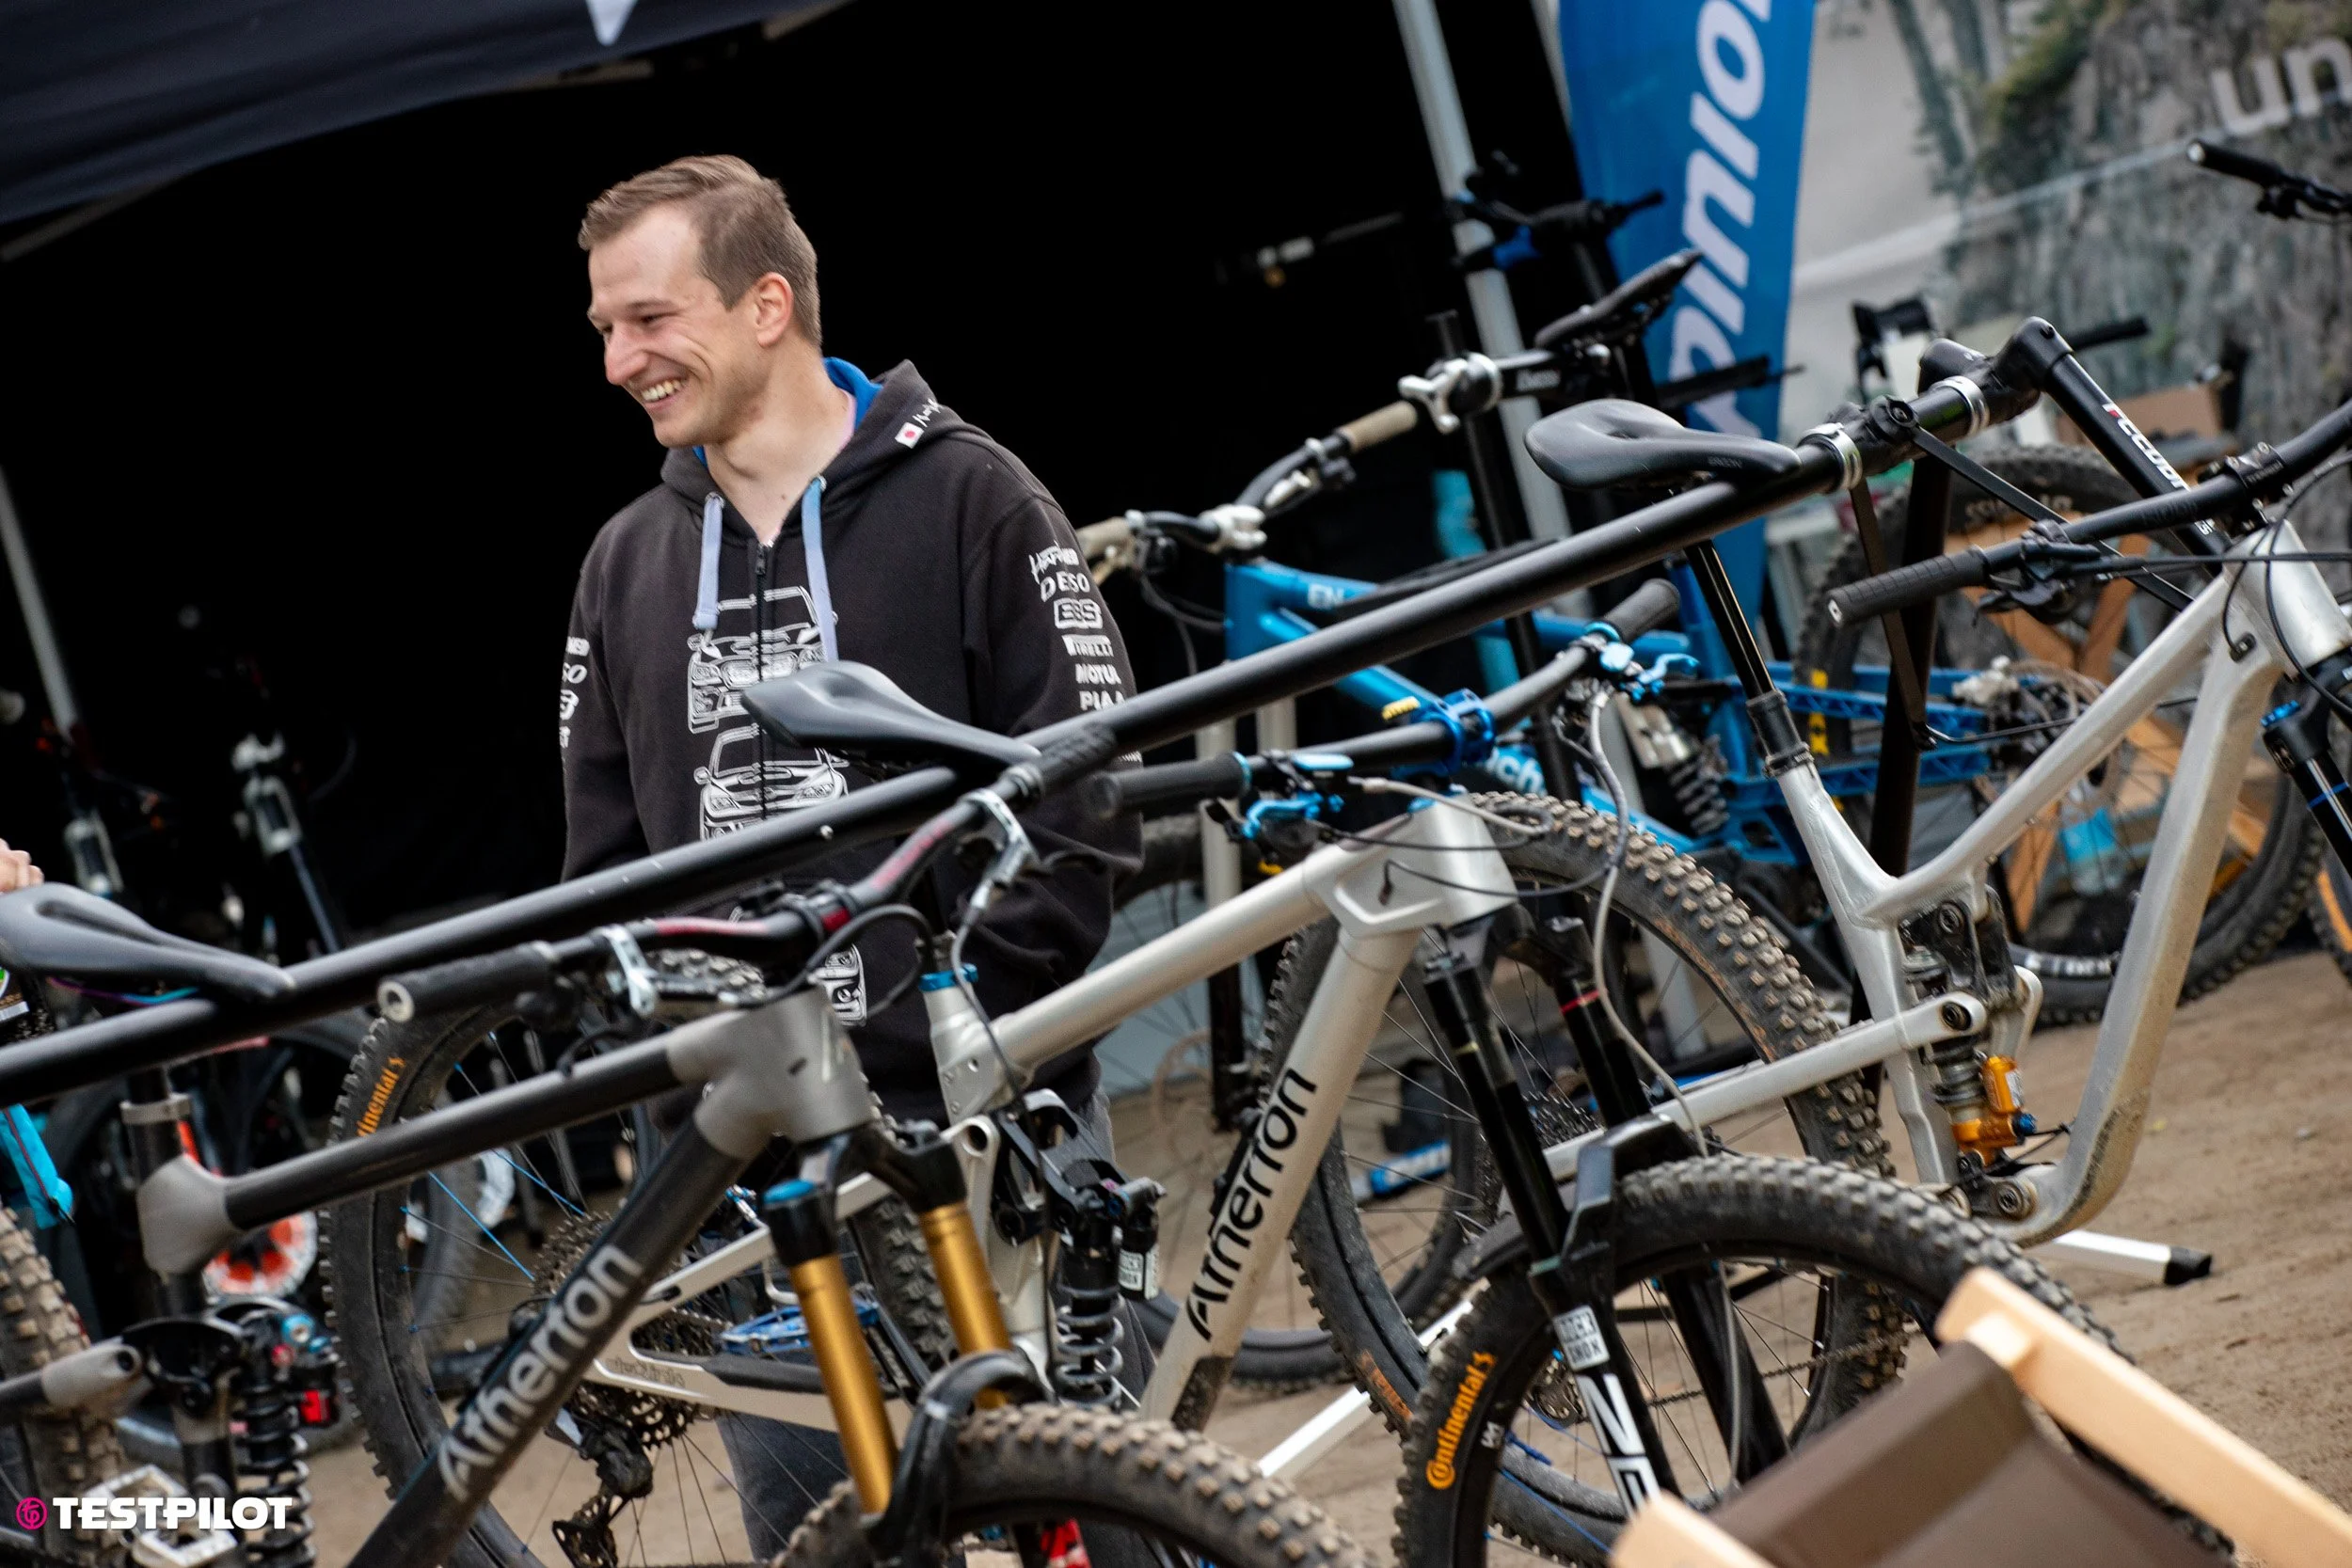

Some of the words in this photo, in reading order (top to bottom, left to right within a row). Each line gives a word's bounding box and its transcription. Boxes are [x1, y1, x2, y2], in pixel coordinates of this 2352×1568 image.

[1669, 0, 1772, 439] pinio
[1075, 663, 1121, 685] MOTUL
[356, 1068, 399, 1136] inental
[1186, 1068, 1317, 1341] Atherton
[437, 1244, 644, 1502] Atherton
[1425, 1364, 1487, 1490] Continental
